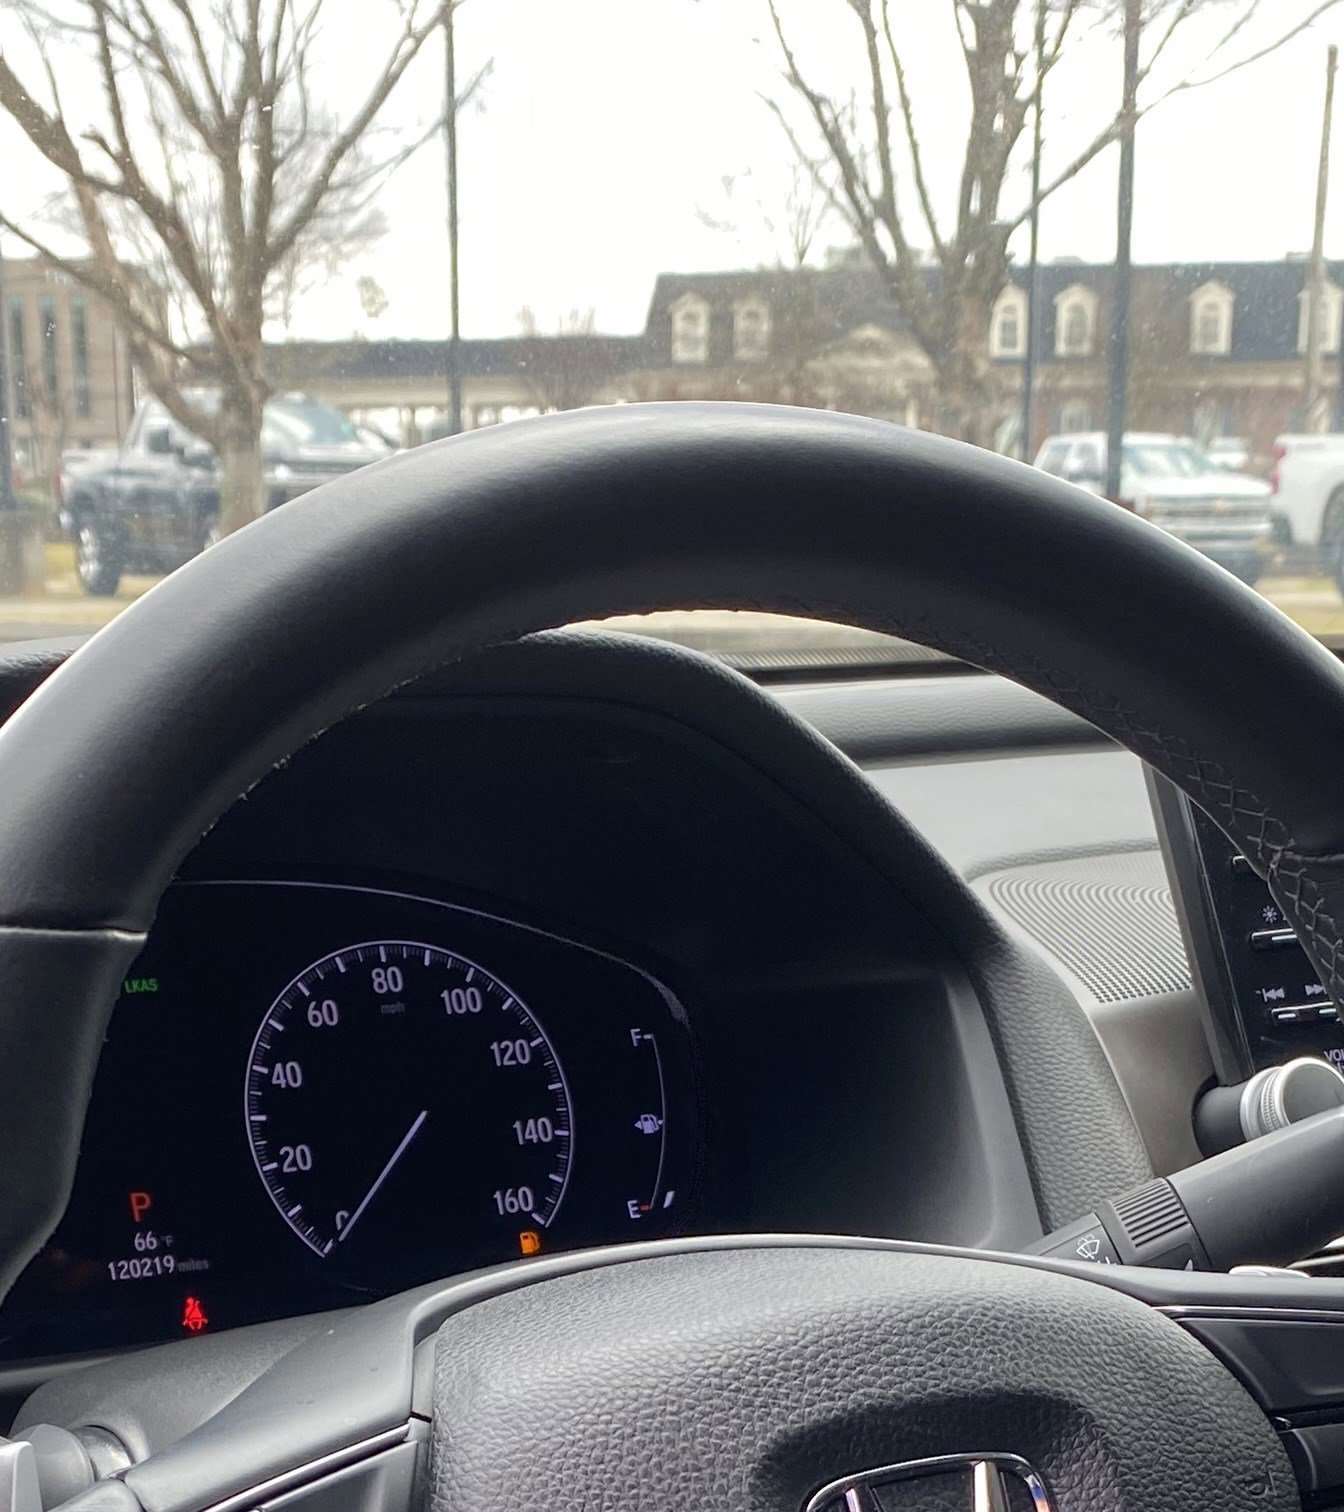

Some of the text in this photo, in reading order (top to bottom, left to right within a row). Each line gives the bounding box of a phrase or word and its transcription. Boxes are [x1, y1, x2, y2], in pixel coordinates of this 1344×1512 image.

[125, 979, 158, 993] LKAS
[371, 965, 404, 994] 80
[307, 999, 339, 1028] 60
[441, 987, 483, 1015] 100
[630, 1028, 642, 1047] F
[490, 1039, 531, 1067] 120
[271, 1061, 303, 1089] 40
[512, 1117, 554, 1146] 140
[279, 1144, 313, 1173] 20
[130, 1192, 152, 1222] P
[493, 1186, 534, 1215] 160
[627, 1200, 641, 1219] E
[134, 1230, 157, 1251] 66
[108, 1255, 209, 1280] 120219 miles
